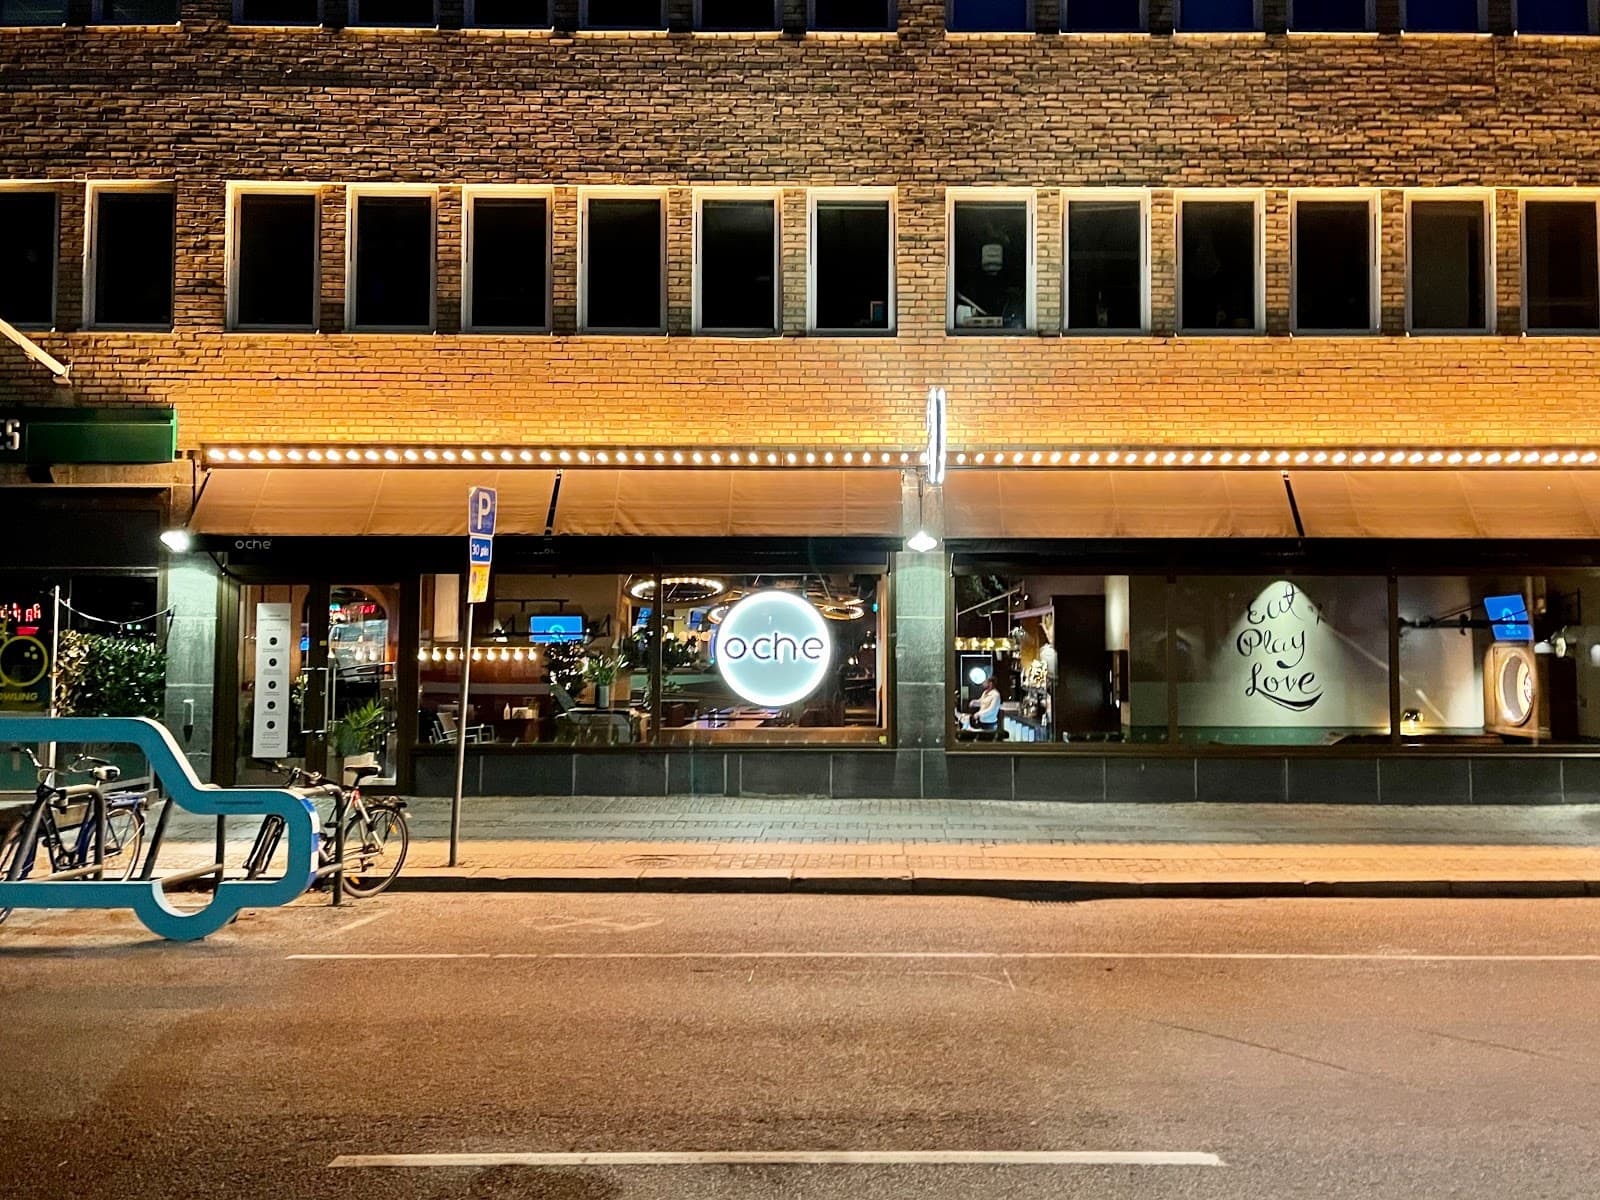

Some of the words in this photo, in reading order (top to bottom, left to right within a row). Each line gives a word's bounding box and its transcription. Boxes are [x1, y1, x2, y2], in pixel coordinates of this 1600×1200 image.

[477, 491, 492, 530] P
[235, 539, 271, 550] oche
[471, 544, 480, 556] 30
[1247, 584, 1303, 625] Eat
[724, 632, 824, 660] oche
[1237, 629, 1305, 669] Play
[1245, 662, 1323, 712] Love
